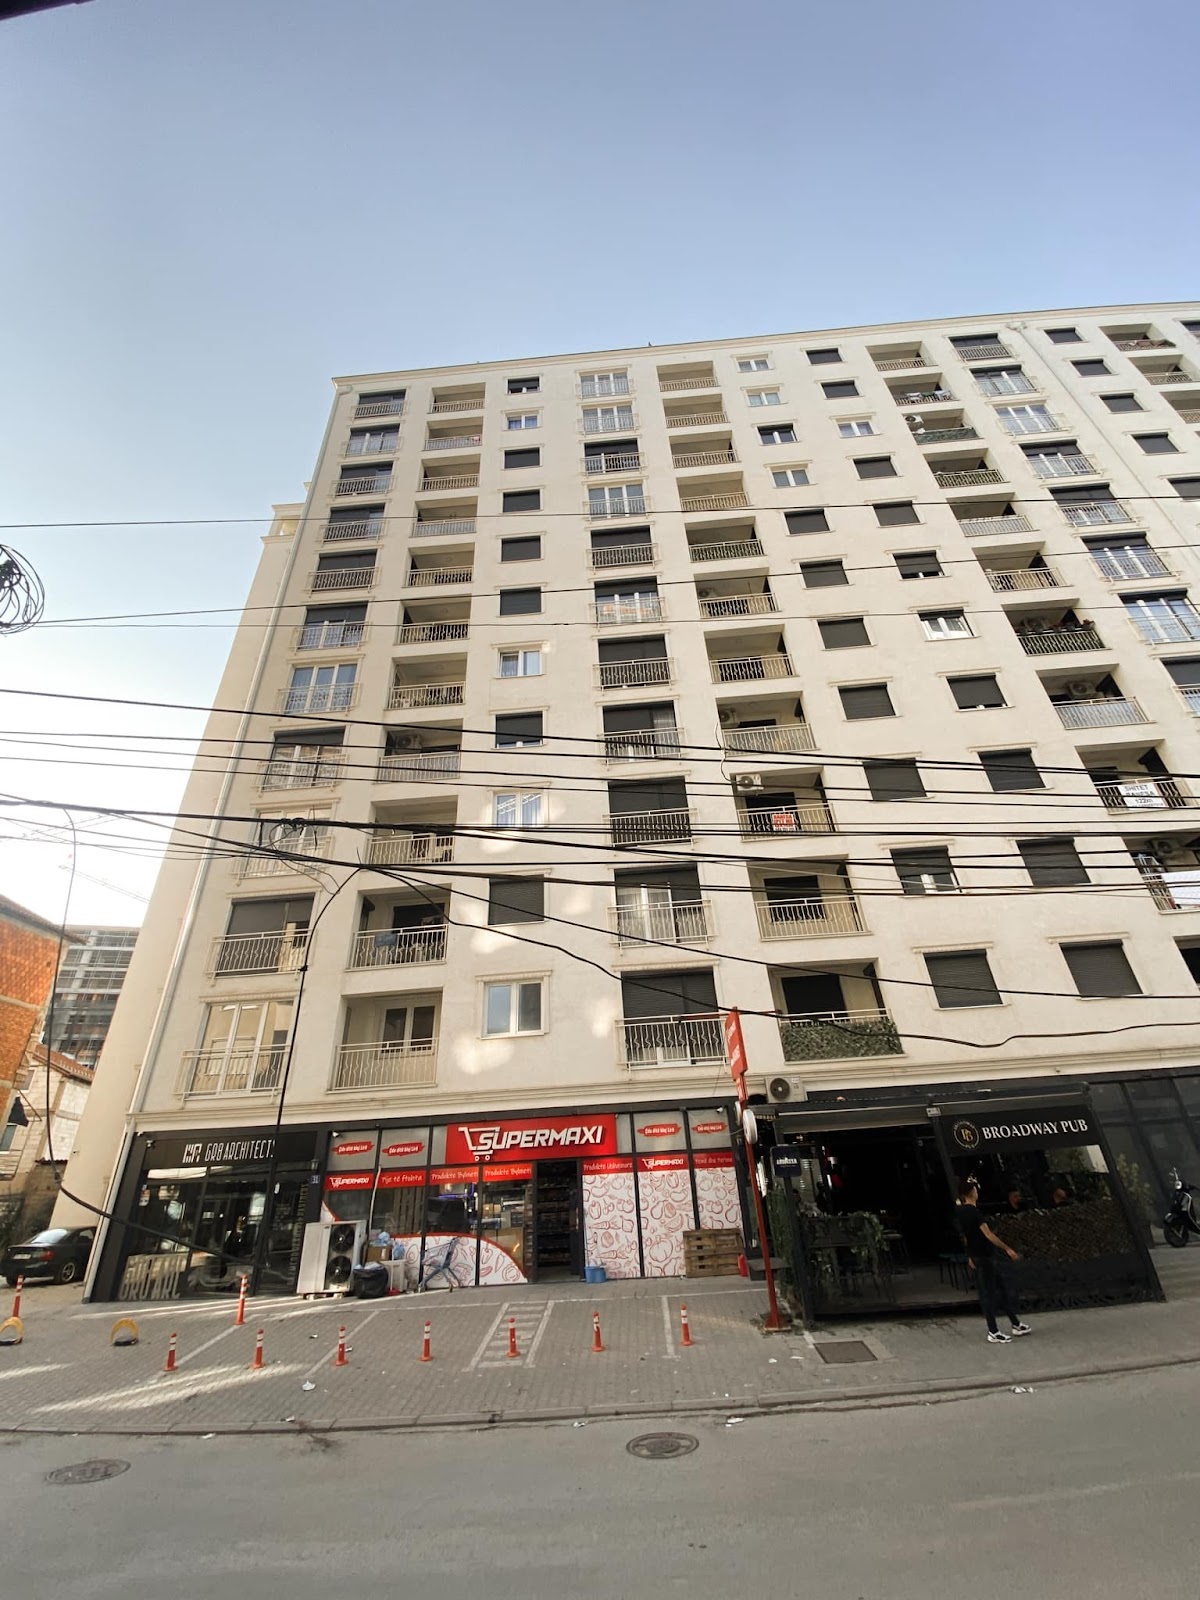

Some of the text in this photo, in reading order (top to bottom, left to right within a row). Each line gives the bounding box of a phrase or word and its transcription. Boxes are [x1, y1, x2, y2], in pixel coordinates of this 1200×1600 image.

[476, 1125, 604, 1151] SUPERMAXI
[981, 1122, 1059, 1140] BROADWAY
[1060, 1118, 1088, 1133] PUB
